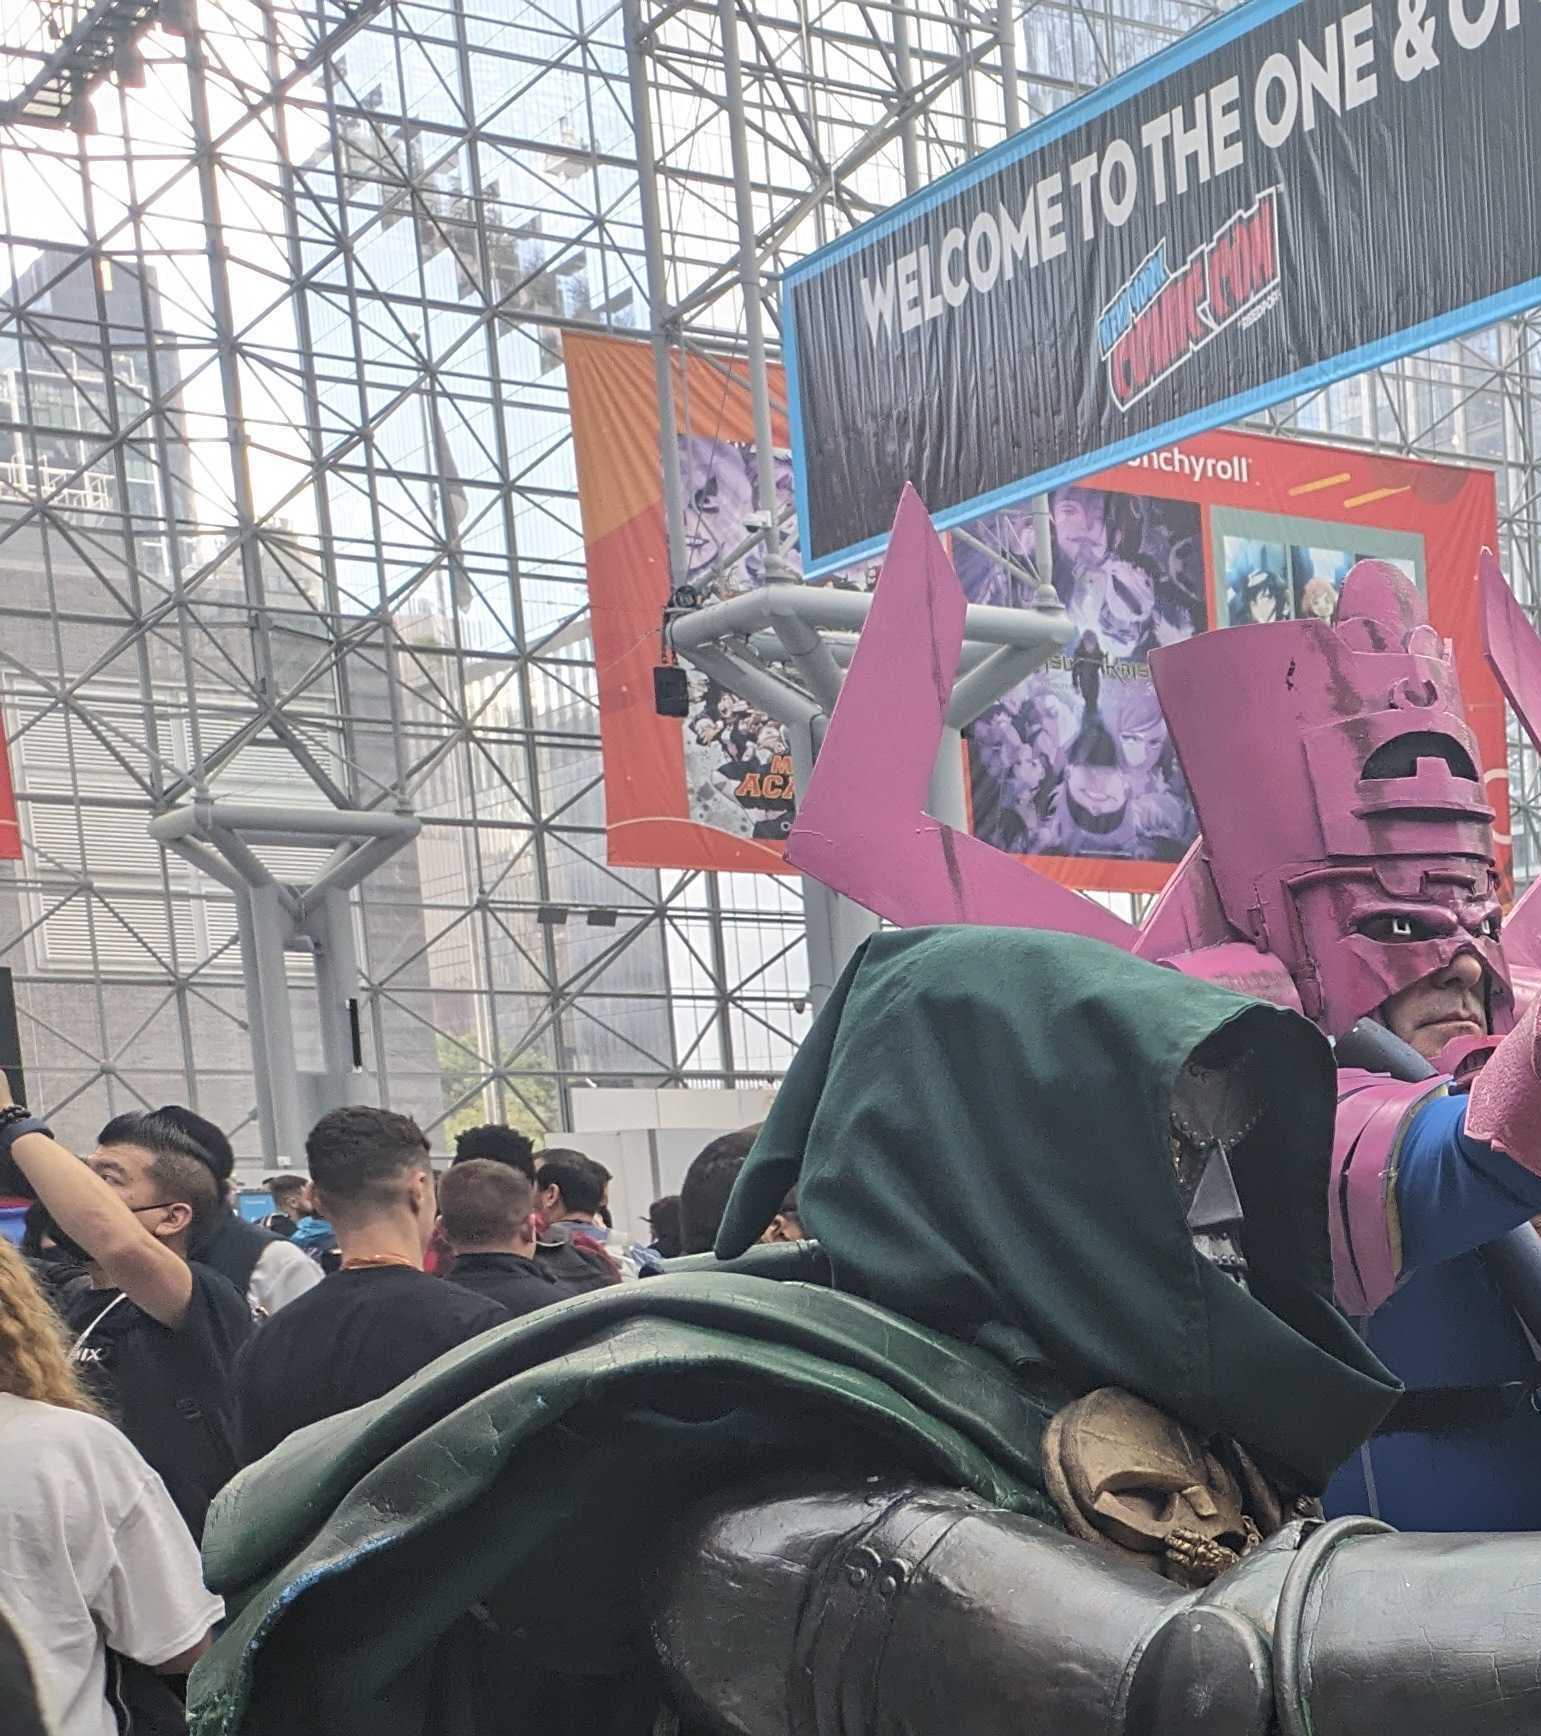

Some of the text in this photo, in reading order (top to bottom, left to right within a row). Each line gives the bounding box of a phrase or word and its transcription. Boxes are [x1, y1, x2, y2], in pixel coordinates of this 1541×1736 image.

[860, 173, 1067, 347] WELCOME
[1071, 139, 1137, 241] TO
[1141, 75, 1244, 206] THE
[1254, 3, 1378, 148] ONE
